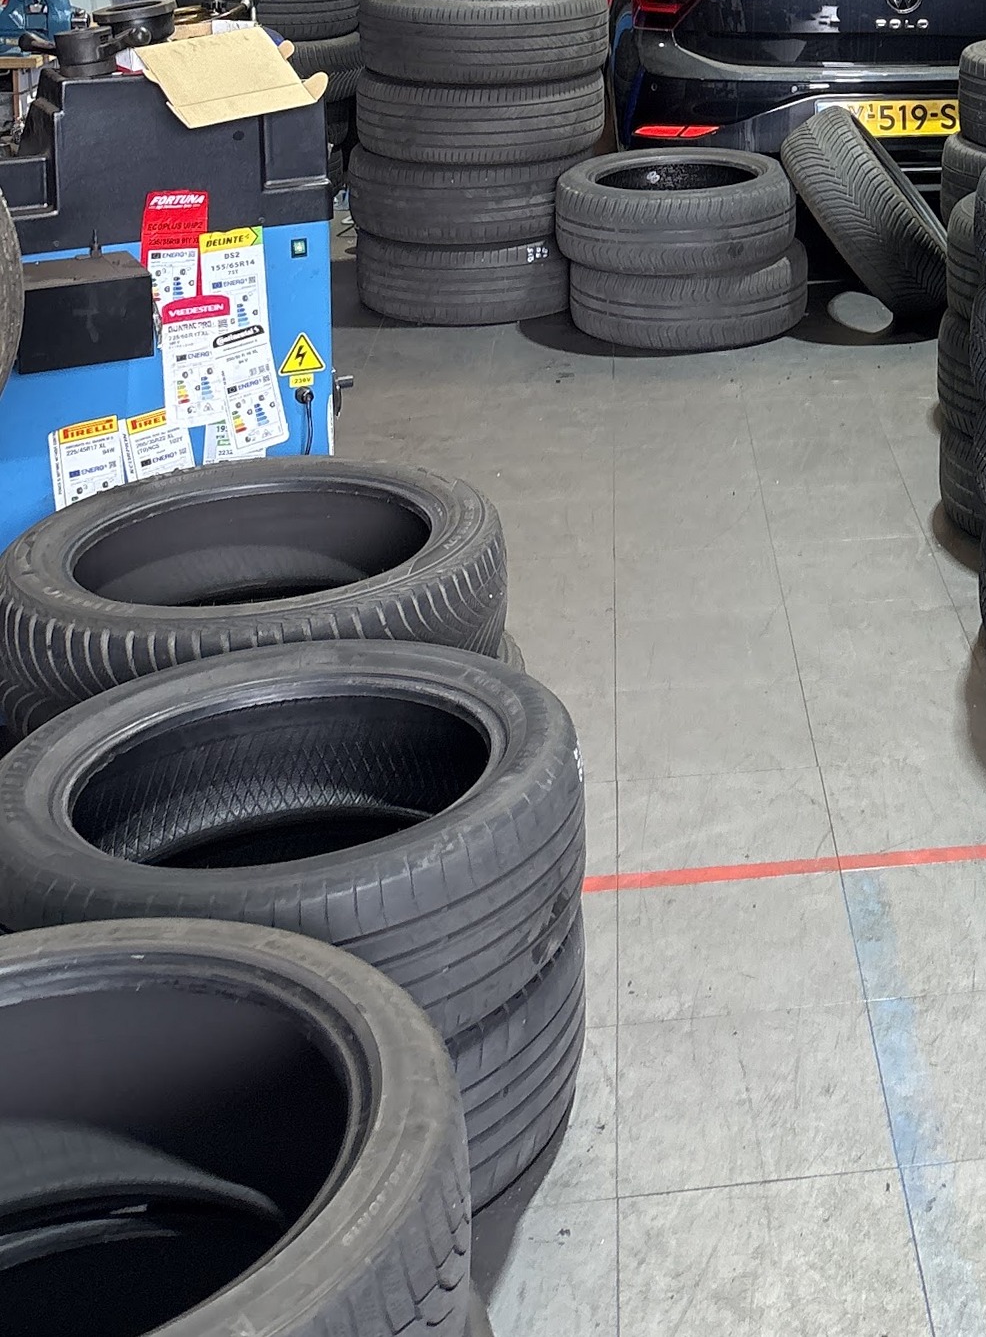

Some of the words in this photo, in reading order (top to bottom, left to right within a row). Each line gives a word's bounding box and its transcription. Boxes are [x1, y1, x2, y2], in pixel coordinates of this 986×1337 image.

[875, 18, 929, 29] POLO
[150, 194, 205, 206] FORTUNA
[206, 234, 244, 248] DELINTE
[224, 251, 240, 260] DS2
[210, 259, 256, 273] 155/65R14
[168, 303, 224, 318] VREDESTEIN
[130, 415, 167, 431] PIREL
[63, 422, 114, 440] PIRELLI
